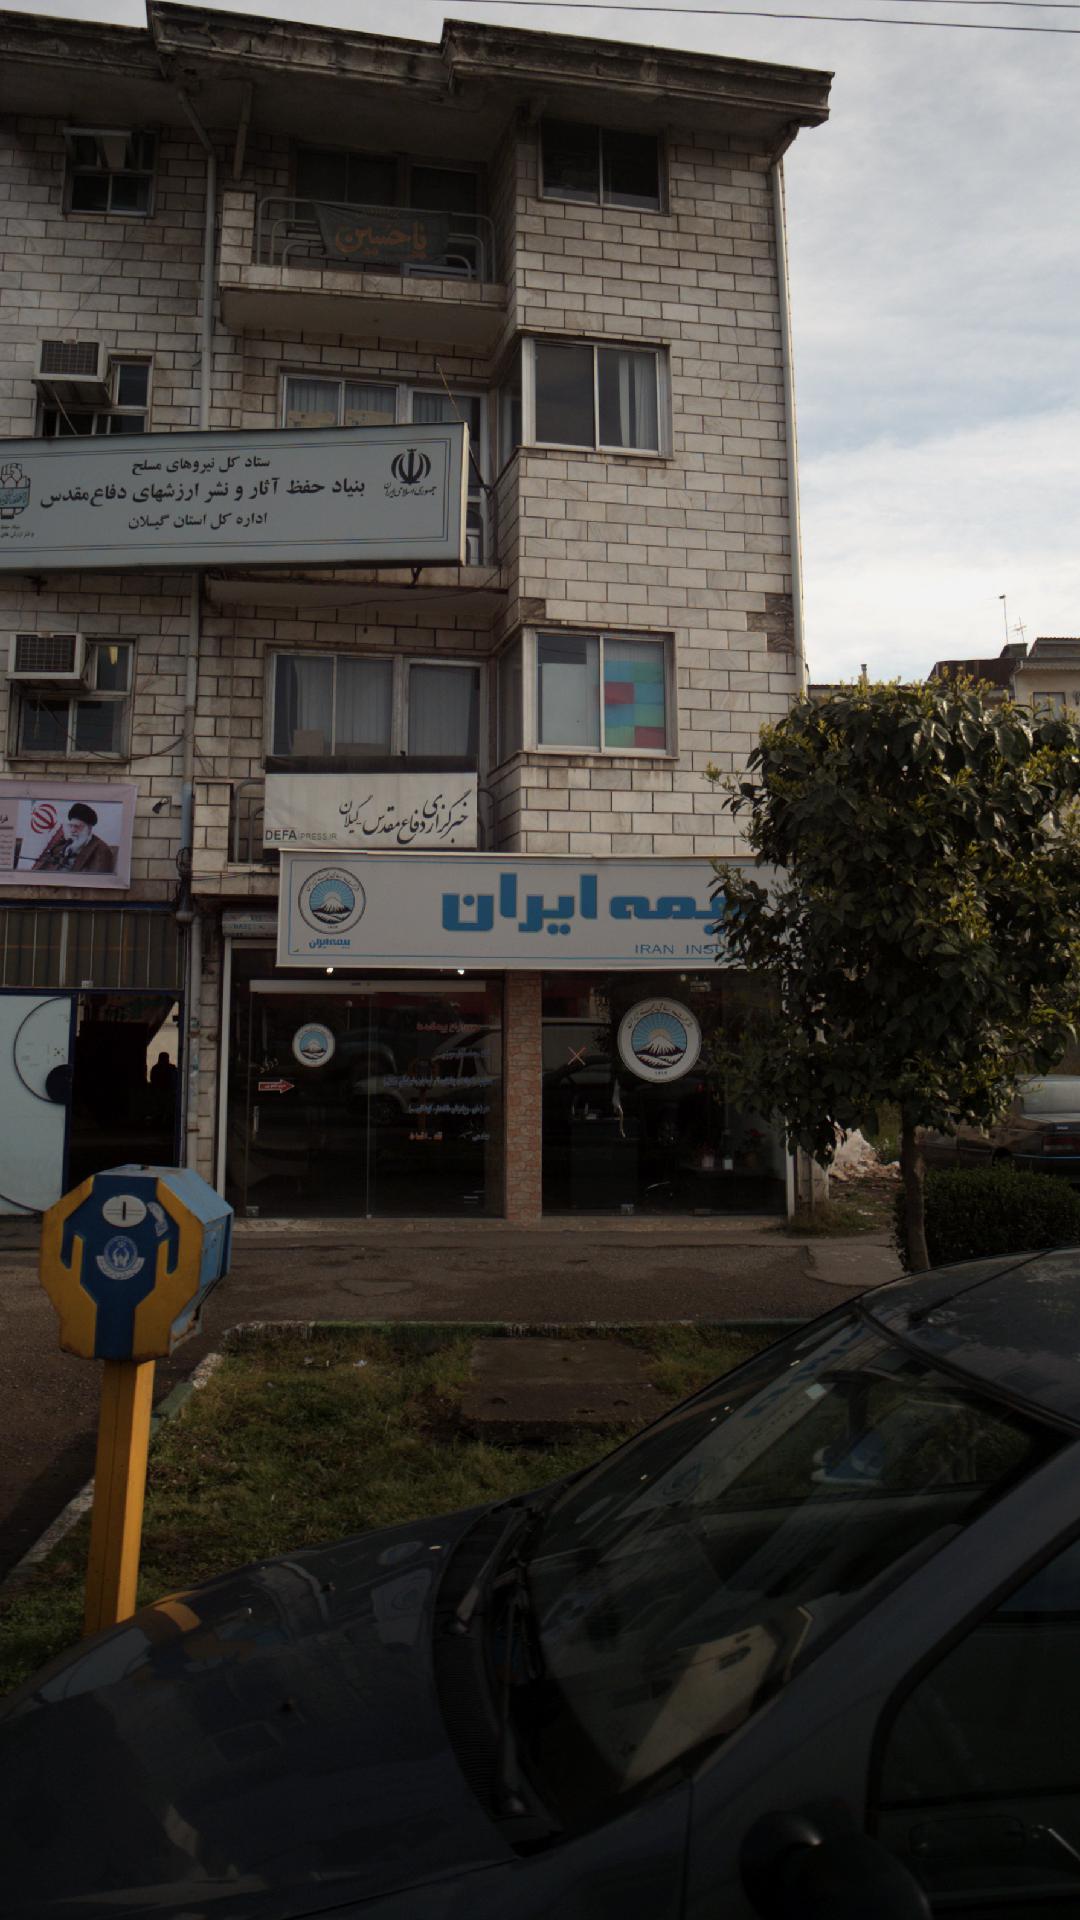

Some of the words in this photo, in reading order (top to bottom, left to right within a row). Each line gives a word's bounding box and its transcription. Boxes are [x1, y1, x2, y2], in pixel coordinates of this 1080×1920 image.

[131, 459, 162, 476] مسلح
[165, 456, 215, 474] نیروهای
[218, 455, 241, 473] کل
[244, 454, 271, 468] ستاد
[132, 482, 199, 503] ارزشهای
[203, 480, 229, 503] نشر
[233, 484, 244, 501] و
[248, 477, 280, 499] آثار
[285, 479, 325, 495] حفظ
[331, 477, 365, 497] بنیاد
[40, 486, 89, 508] مقدس
[128, 513, 170, 530] گیلان
[173, 513, 207, 529] استان
[209, 512, 233, 530] کل
[235, 511, 268, 528] اداره
[338, 794, 374, 834] گیلان
[362, 805, 400, 836] مقدس
[265, 829, 298, 841] DEFA
[396, 809, 426, 844] دفاع
[442, 873, 598, 935] ایران
[634, 943, 675, 955] IRAN
